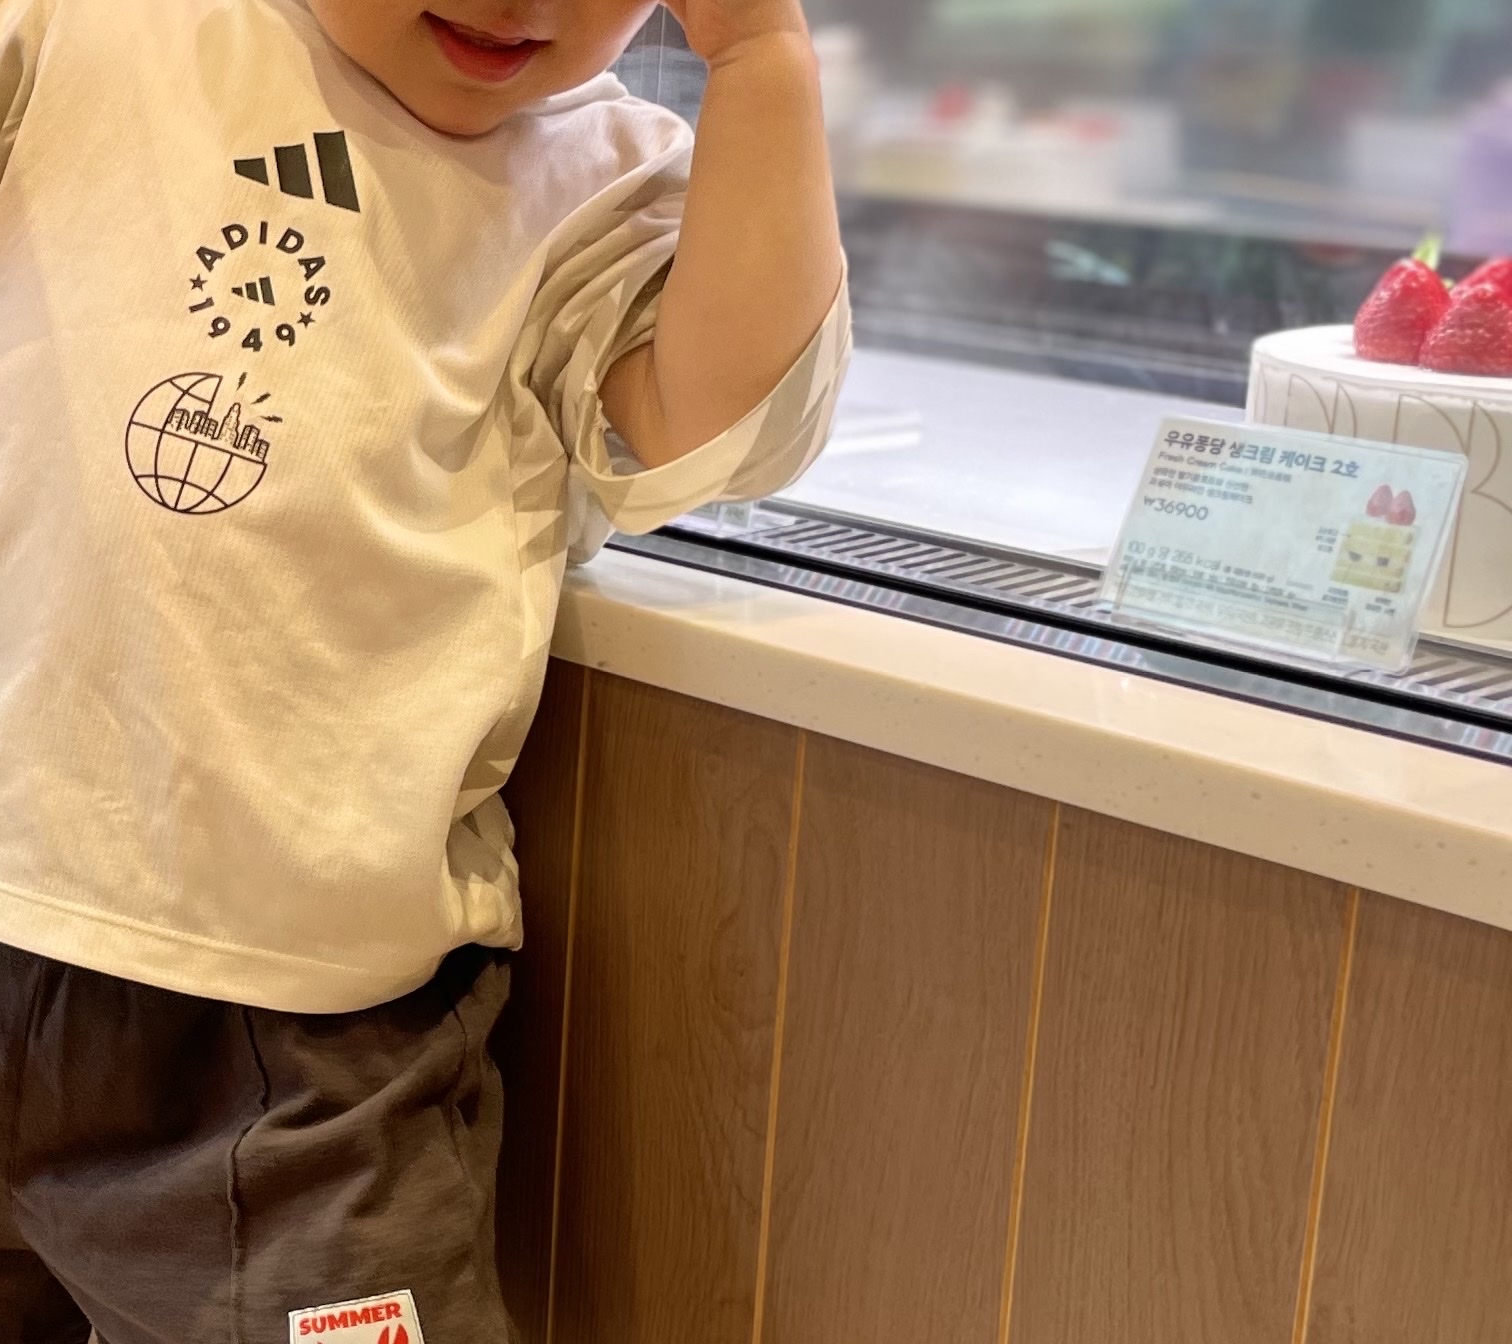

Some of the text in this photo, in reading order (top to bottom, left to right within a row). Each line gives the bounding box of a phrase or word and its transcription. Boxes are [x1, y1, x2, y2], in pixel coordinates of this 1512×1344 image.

[195, 220, 331, 307] ADIDAS
[188, 296, 297, 353] 1949
[1157, 450, 1185, 464] Fresh
[1186, 456, 1217, 470] Cream
[1163, 429, 1361, 479] 우유퐁당 생크림 케이크 2호
[1195, 551, 1222, 571] kcal
[299, 1301, 403, 1336] SUMMER
